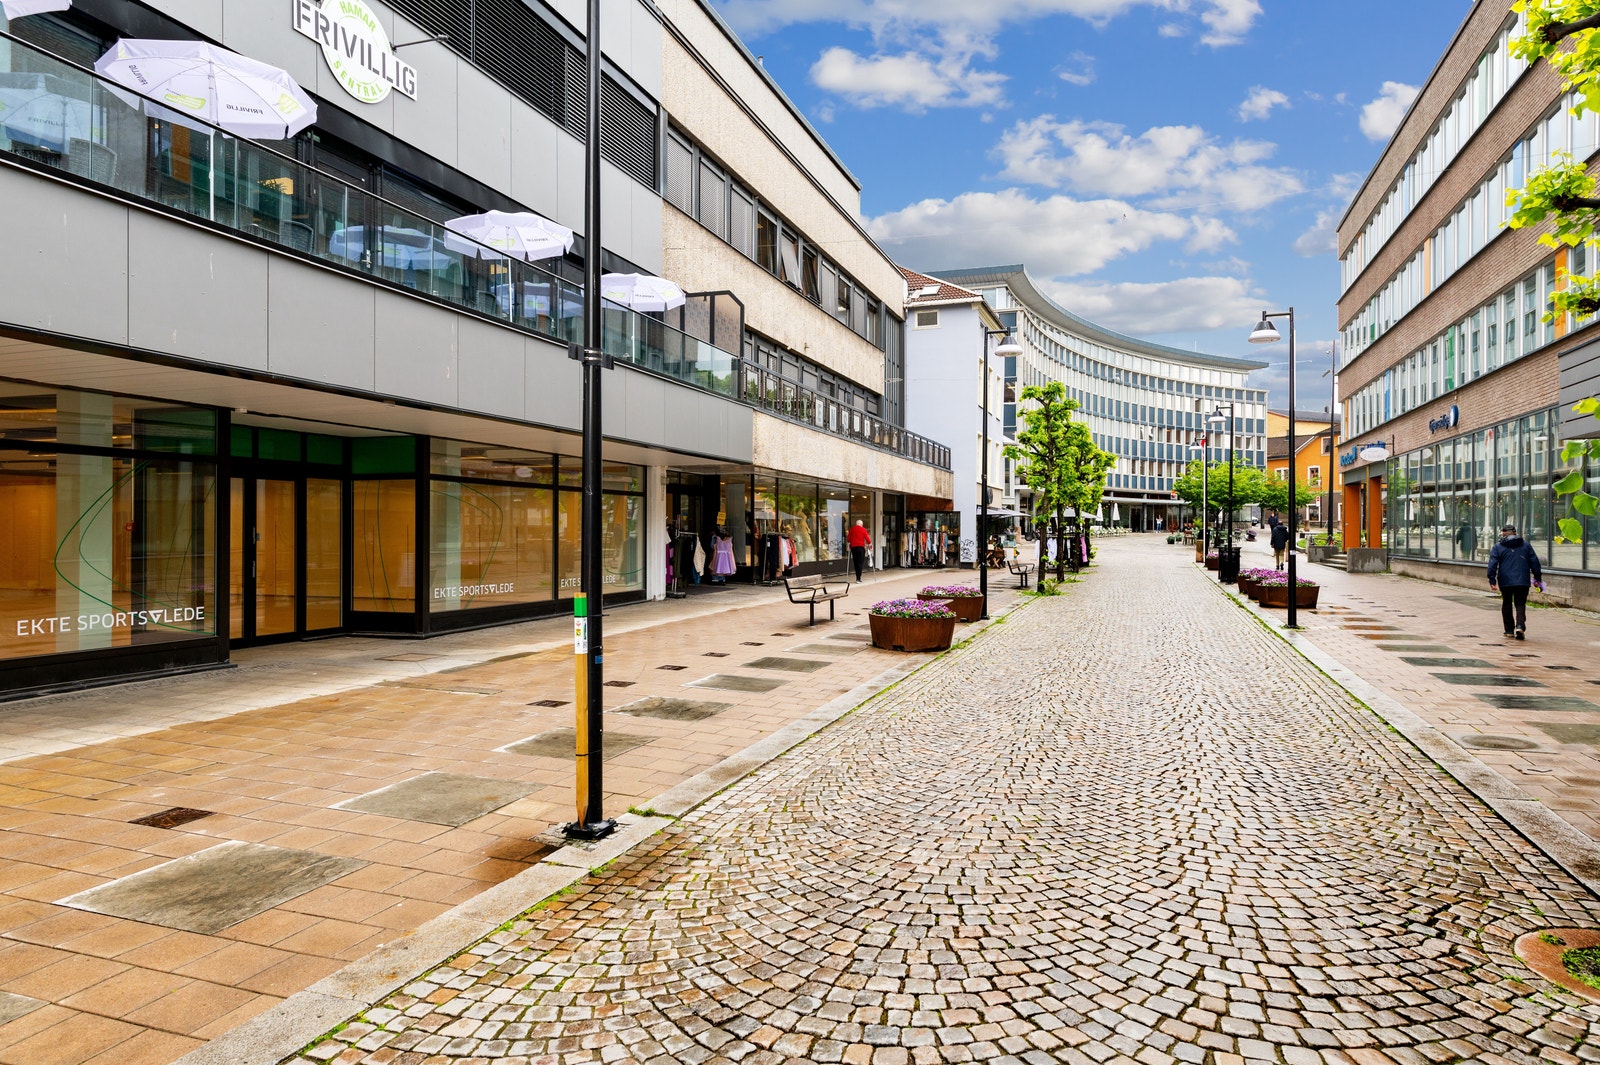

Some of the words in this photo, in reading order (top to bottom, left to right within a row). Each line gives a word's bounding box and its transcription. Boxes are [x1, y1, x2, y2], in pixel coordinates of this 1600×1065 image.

[339, 1, 377, 32] HAMAR
[296, 0, 415, 96] FRIVILLIG
[333, 60, 383, 97] SENTRAL
[434, 586, 457, 599] EKTE
[560, 578, 578, 588] EKTE
[17, 616, 71, 636] EKTE
